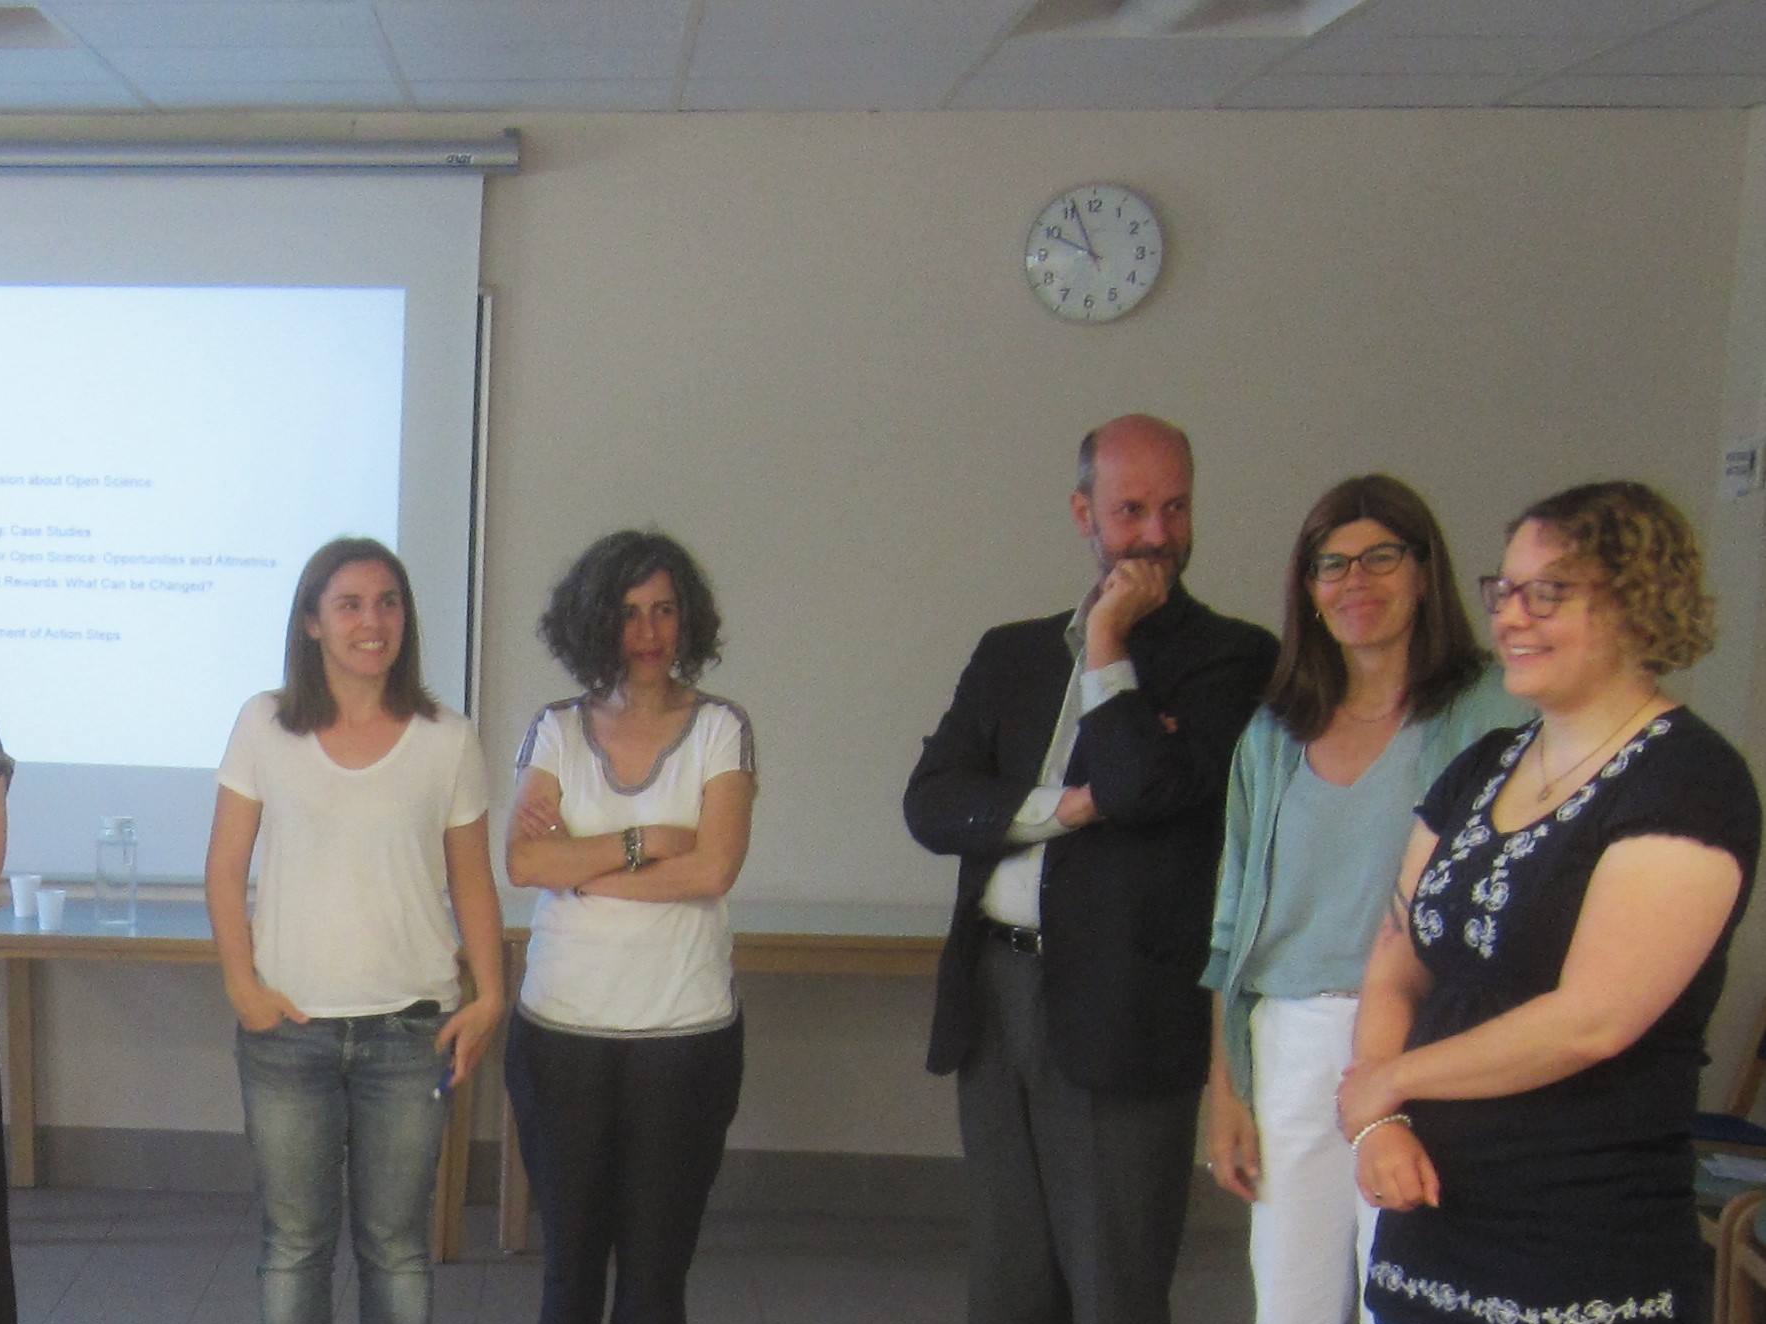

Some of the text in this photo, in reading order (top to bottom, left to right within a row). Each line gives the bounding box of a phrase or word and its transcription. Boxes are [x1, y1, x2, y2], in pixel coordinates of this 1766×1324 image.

[1086, 198, 1103, 213] 12
[1045, 225, 1062, 239] 10
[1129, 221, 1139, 235] 2
[1135, 246, 1146, 260] 3
[1043, 271, 1054, 285] 8
[1126, 270, 1136, 284] 4
[1059, 288, 1070, 302] 7
[1084, 294, 1094, 308] 6
[1107, 287, 1118, 301] 5
[27, 473, 62, 486] about
[65, 474, 99, 490] Open
[103, 475, 155, 488] Science
[10, 525, 42, 537] Case
[46, 525, 92, 538] Studies
[10, 550, 43, 564] Open
[102, 552, 185, 567] Opportunities
[189, 554, 213, 566] and
[64, 577, 98, 589] What
[100, 578, 126, 590] Can
[130, 578, 145, 590] be
[29, 626, 42, 638] of
[44, 627, 82, 640] Action
[85, 629, 121, 643] Steps
